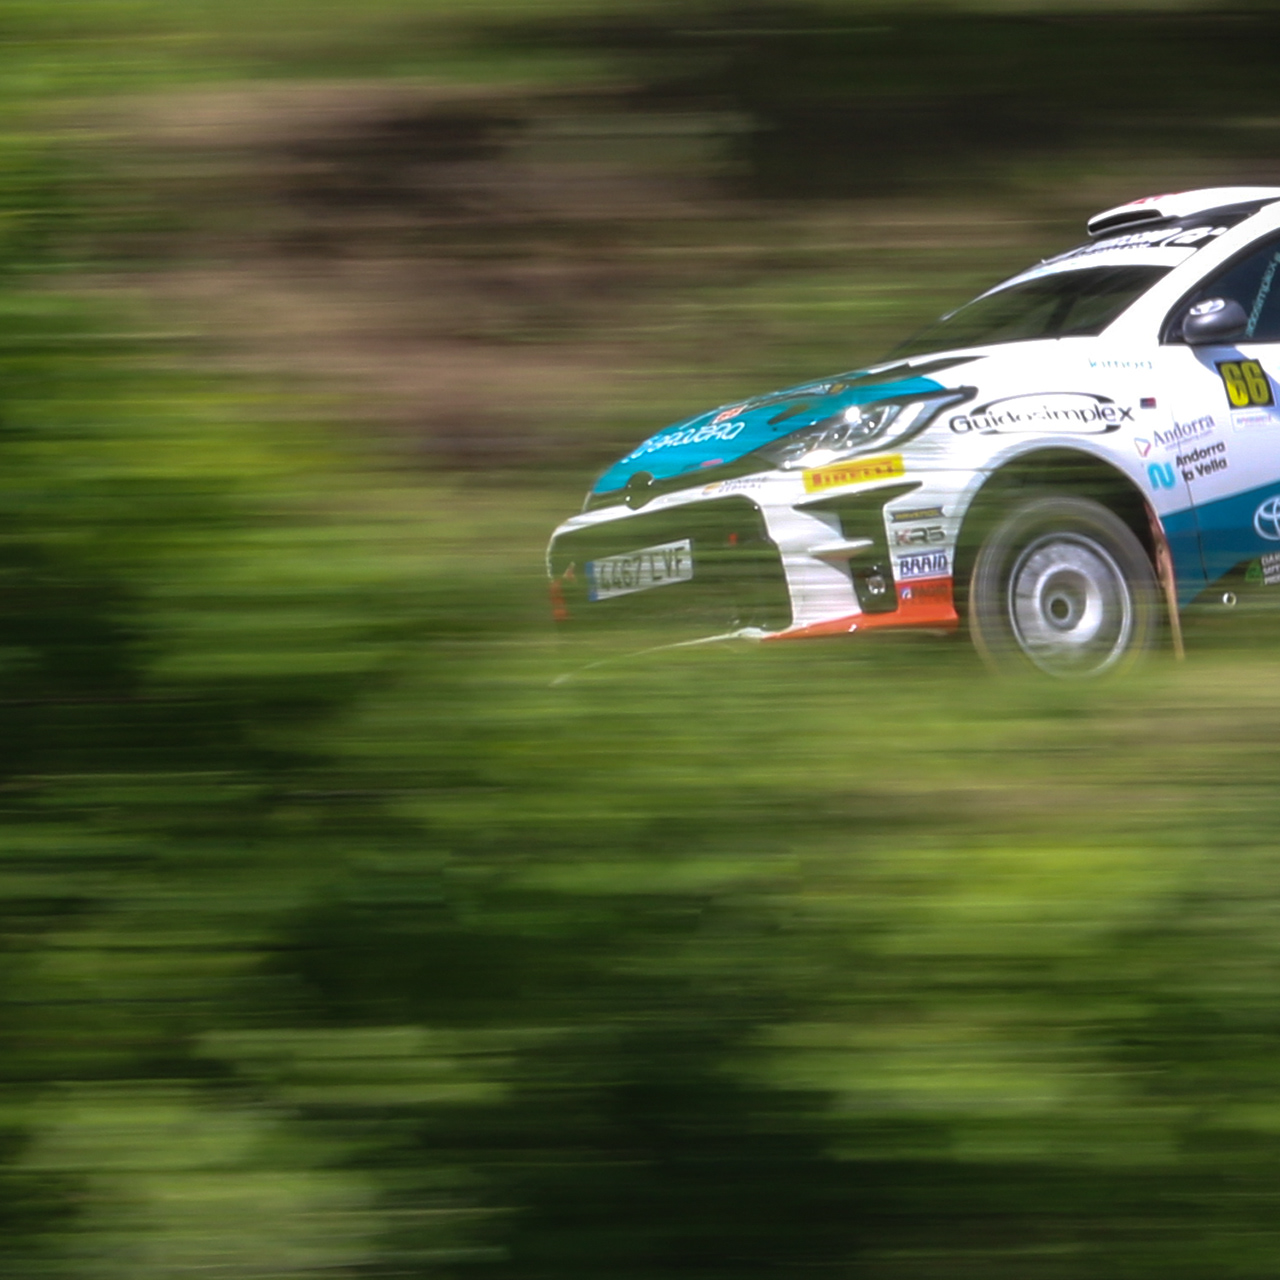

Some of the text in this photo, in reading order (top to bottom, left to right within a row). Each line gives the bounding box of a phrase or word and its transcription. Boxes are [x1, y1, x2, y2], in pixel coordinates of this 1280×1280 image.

[1221, 361, 1270, 407] 66
[948, 403, 1136, 435] Guidosimplex
[1152, 412, 1216, 448] Andorra
[1175, 439, 1226, 469] Andorra
[1196, 457, 1228, 478] Vella
